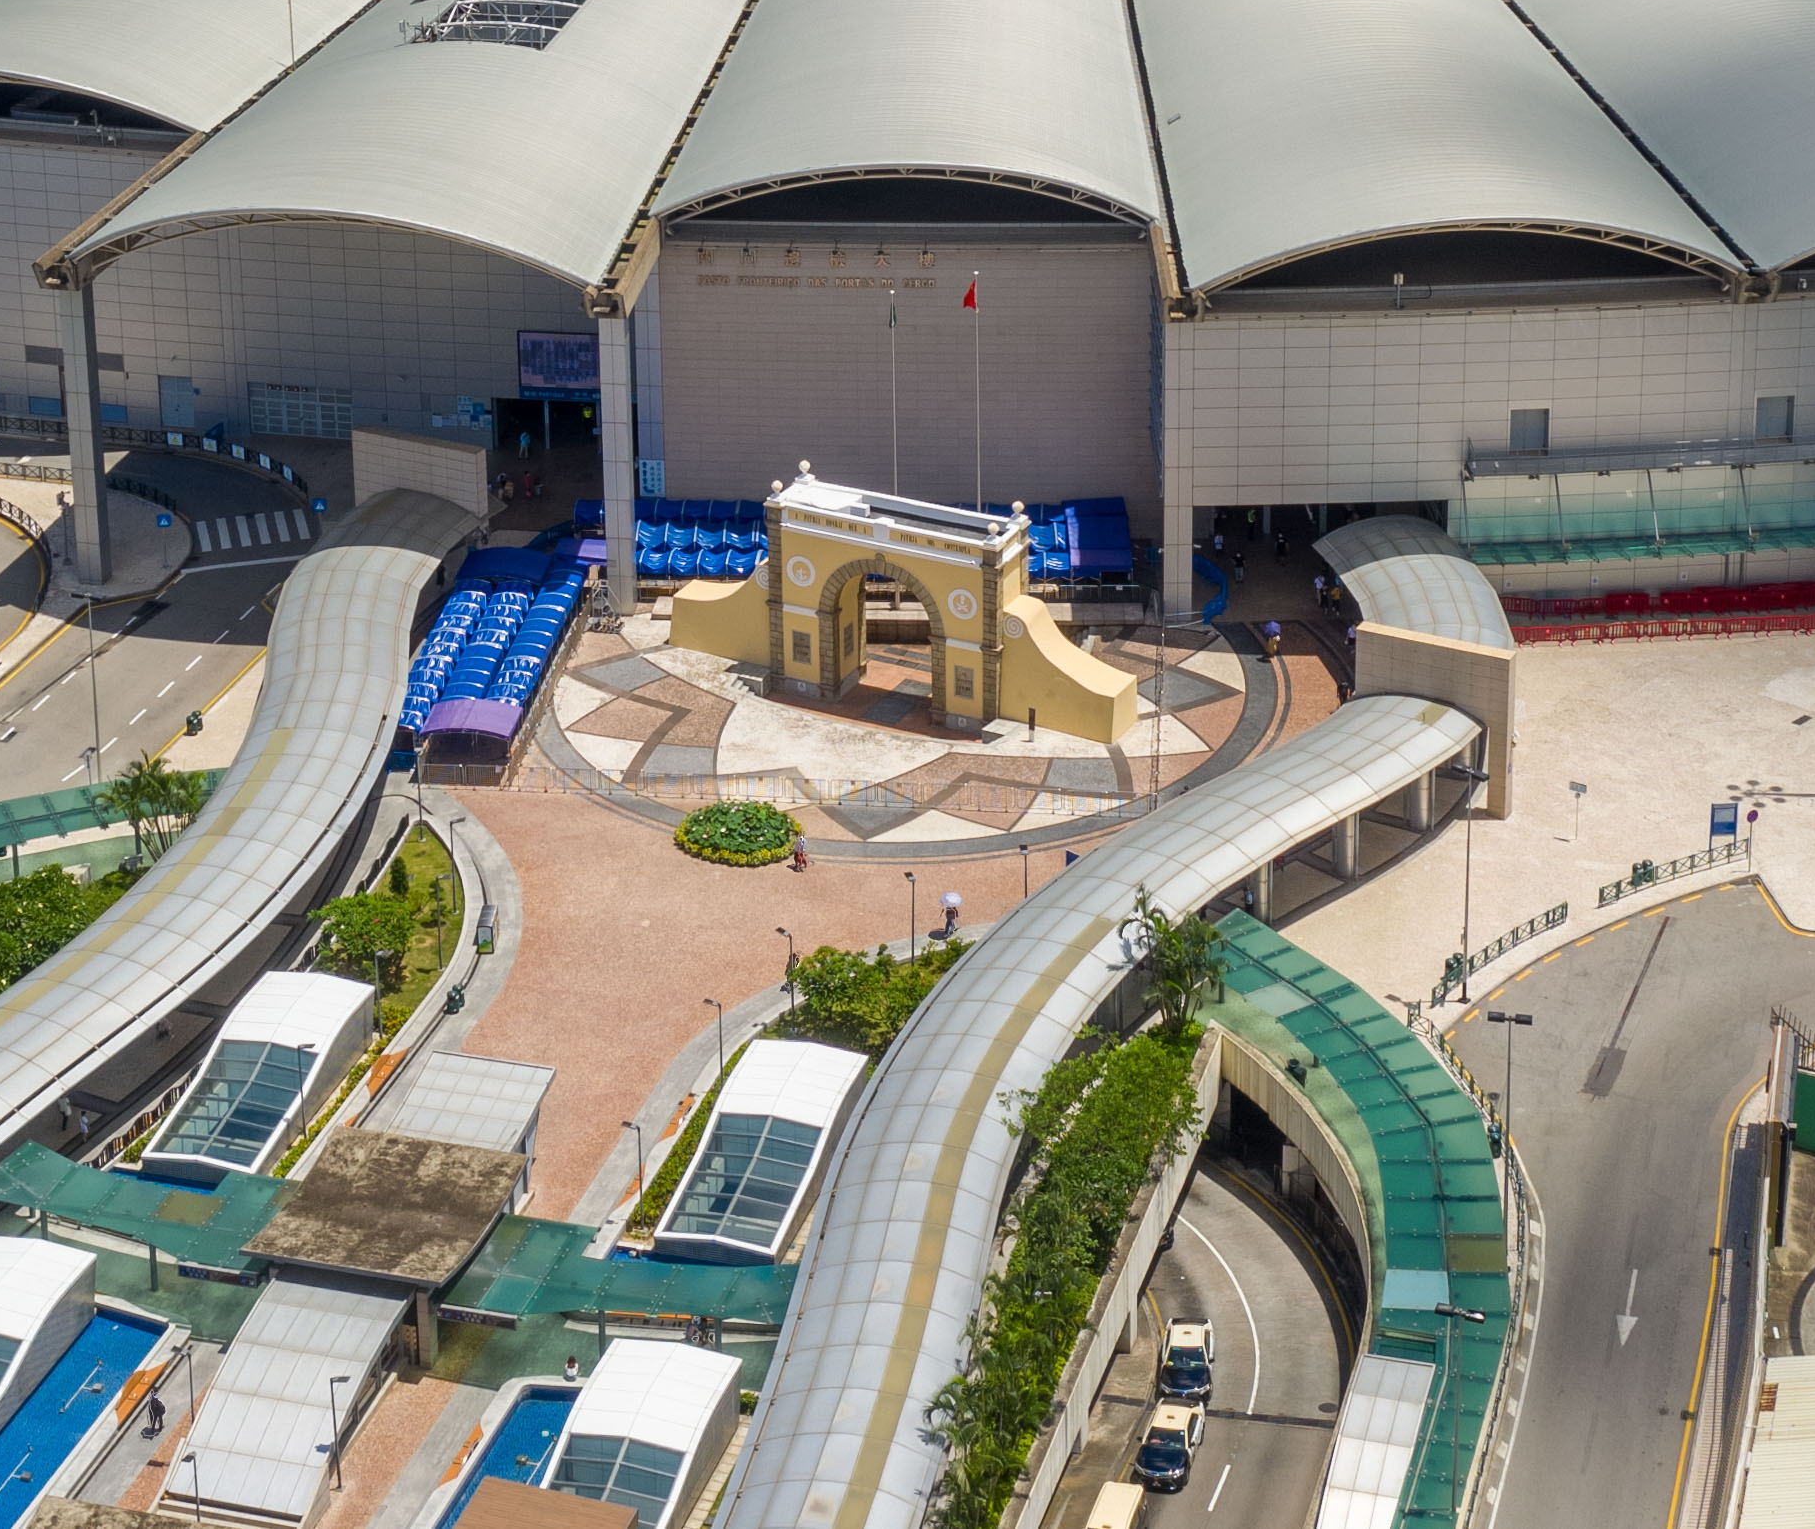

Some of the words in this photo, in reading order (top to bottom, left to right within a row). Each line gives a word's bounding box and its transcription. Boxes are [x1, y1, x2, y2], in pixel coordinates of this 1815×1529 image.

[698, 274, 730, 286] POSTO
[808, 277, 827, 287] DAS
[835, 277, 875, 288] PORTAS
[882, 277, 894, 288] DO
[902, 277, 935, 288] CERCO
